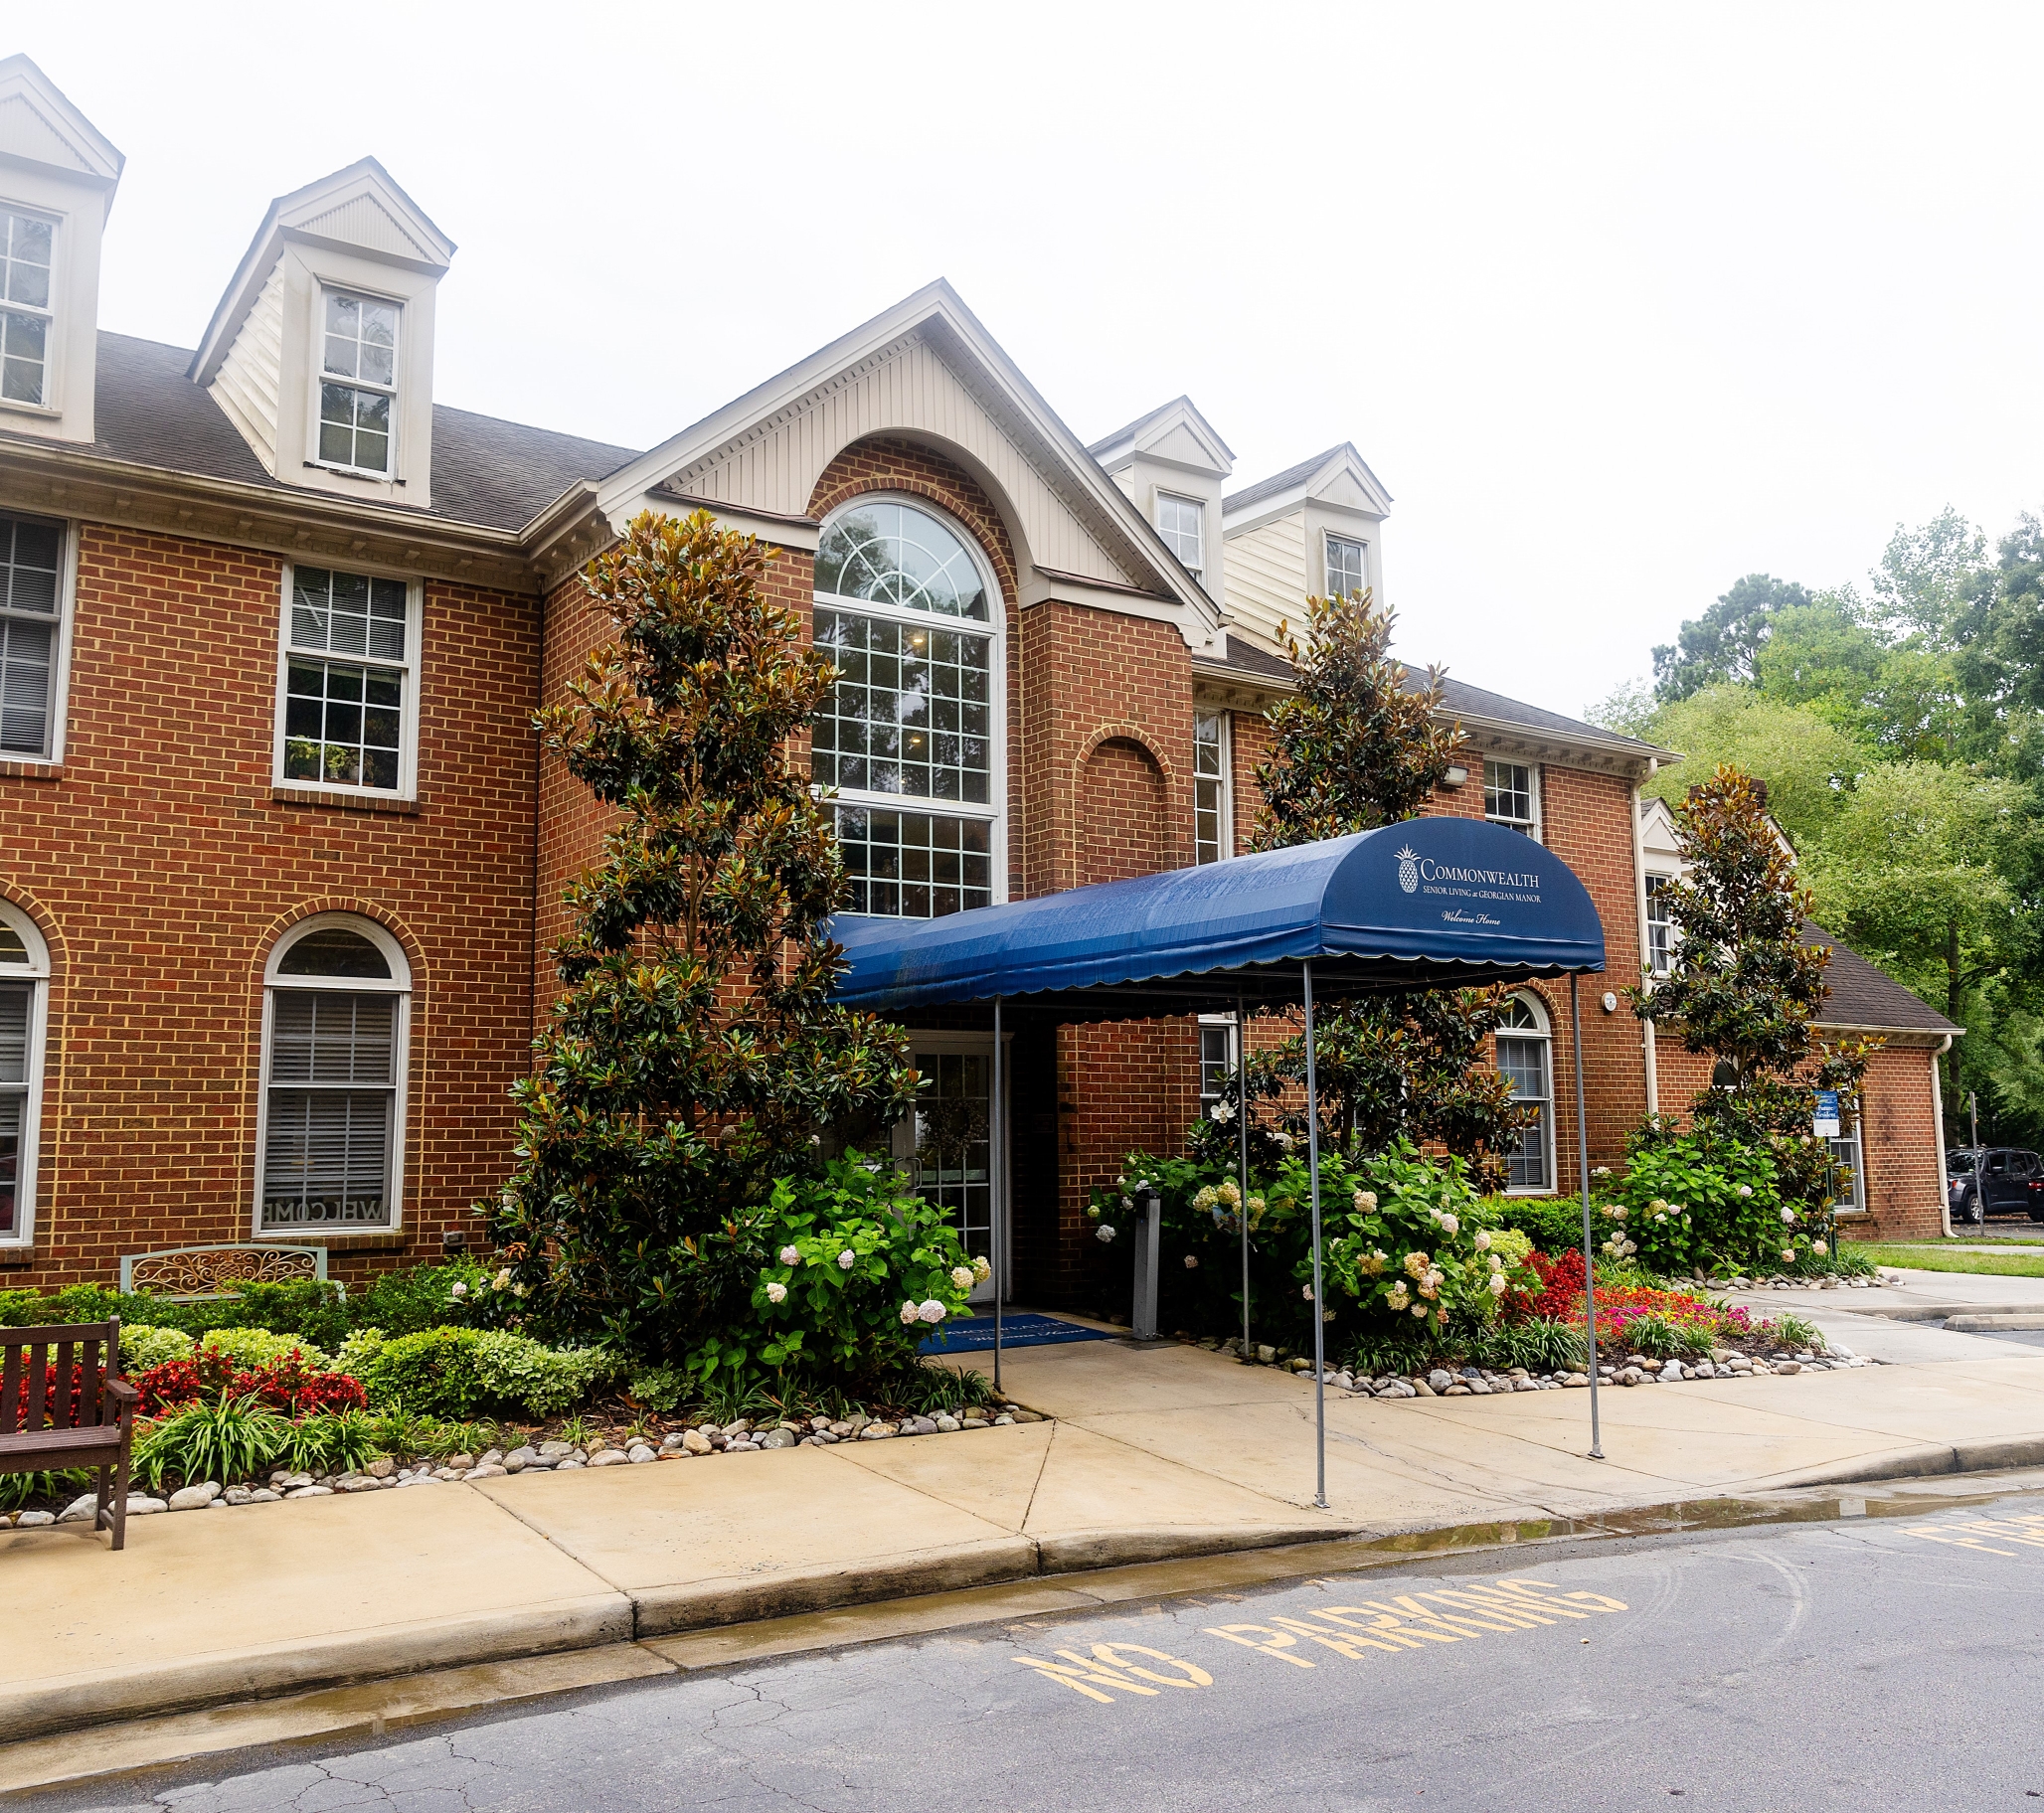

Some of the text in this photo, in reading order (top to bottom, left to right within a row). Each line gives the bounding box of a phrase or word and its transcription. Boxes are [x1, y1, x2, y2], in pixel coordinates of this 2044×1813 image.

[1420, 859, 1540, 889] COMMONWEALTH
[1423, 886, 1448, 896] SENIOR
[1448, 888, 1471, 898] LIVING
[1478, 890, 1515, 902] GEORGIAN
[1515, 894, 1541, 904] MANOR
[1442, 908, 1501, 925] Welcome Home
[1010, 1578, 1628, 1703] NO PARKING
